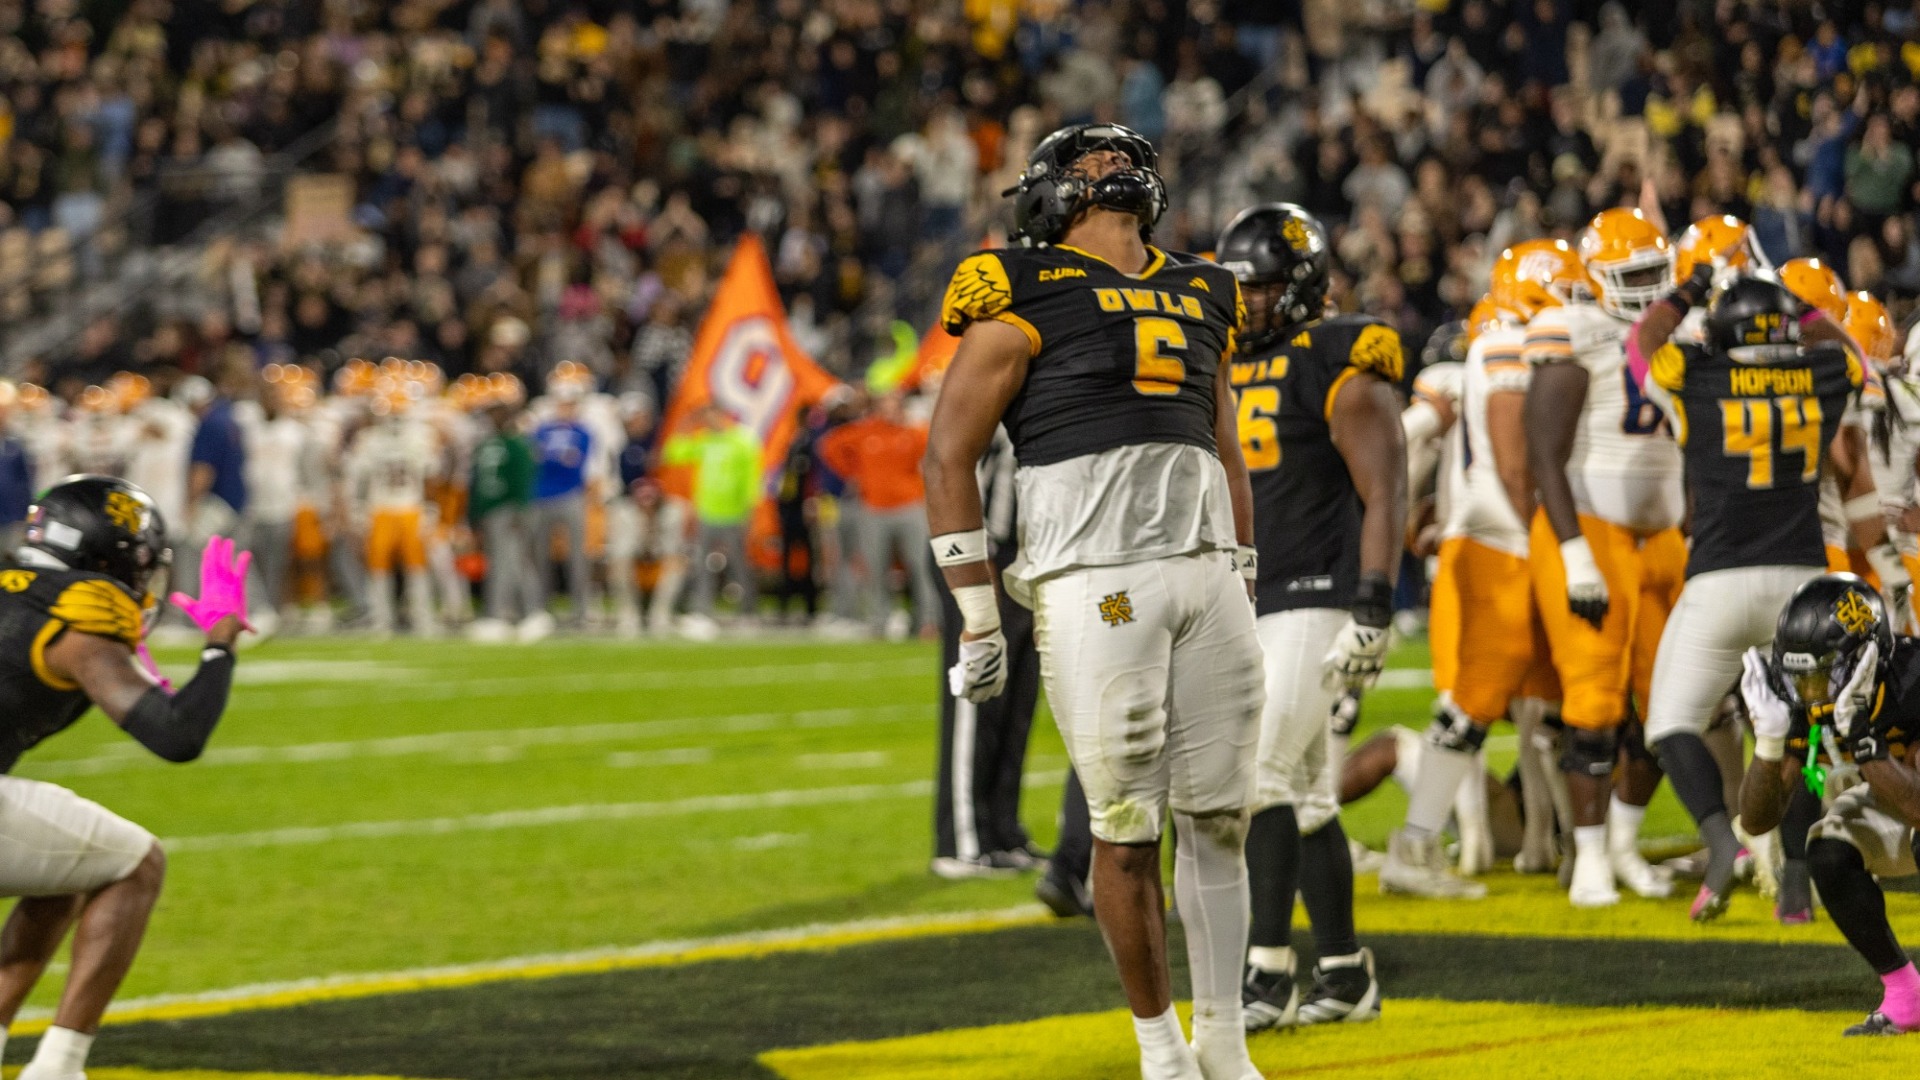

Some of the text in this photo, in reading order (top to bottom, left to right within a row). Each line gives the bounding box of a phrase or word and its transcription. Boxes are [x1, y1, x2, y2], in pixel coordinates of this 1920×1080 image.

[1092, 287, 1205, 320] OWLS
[1132, 316, 1188, 396] 6
[1730, 367, 1812, 396] HOPSON
[1719, 396, 1823, 489] 44
